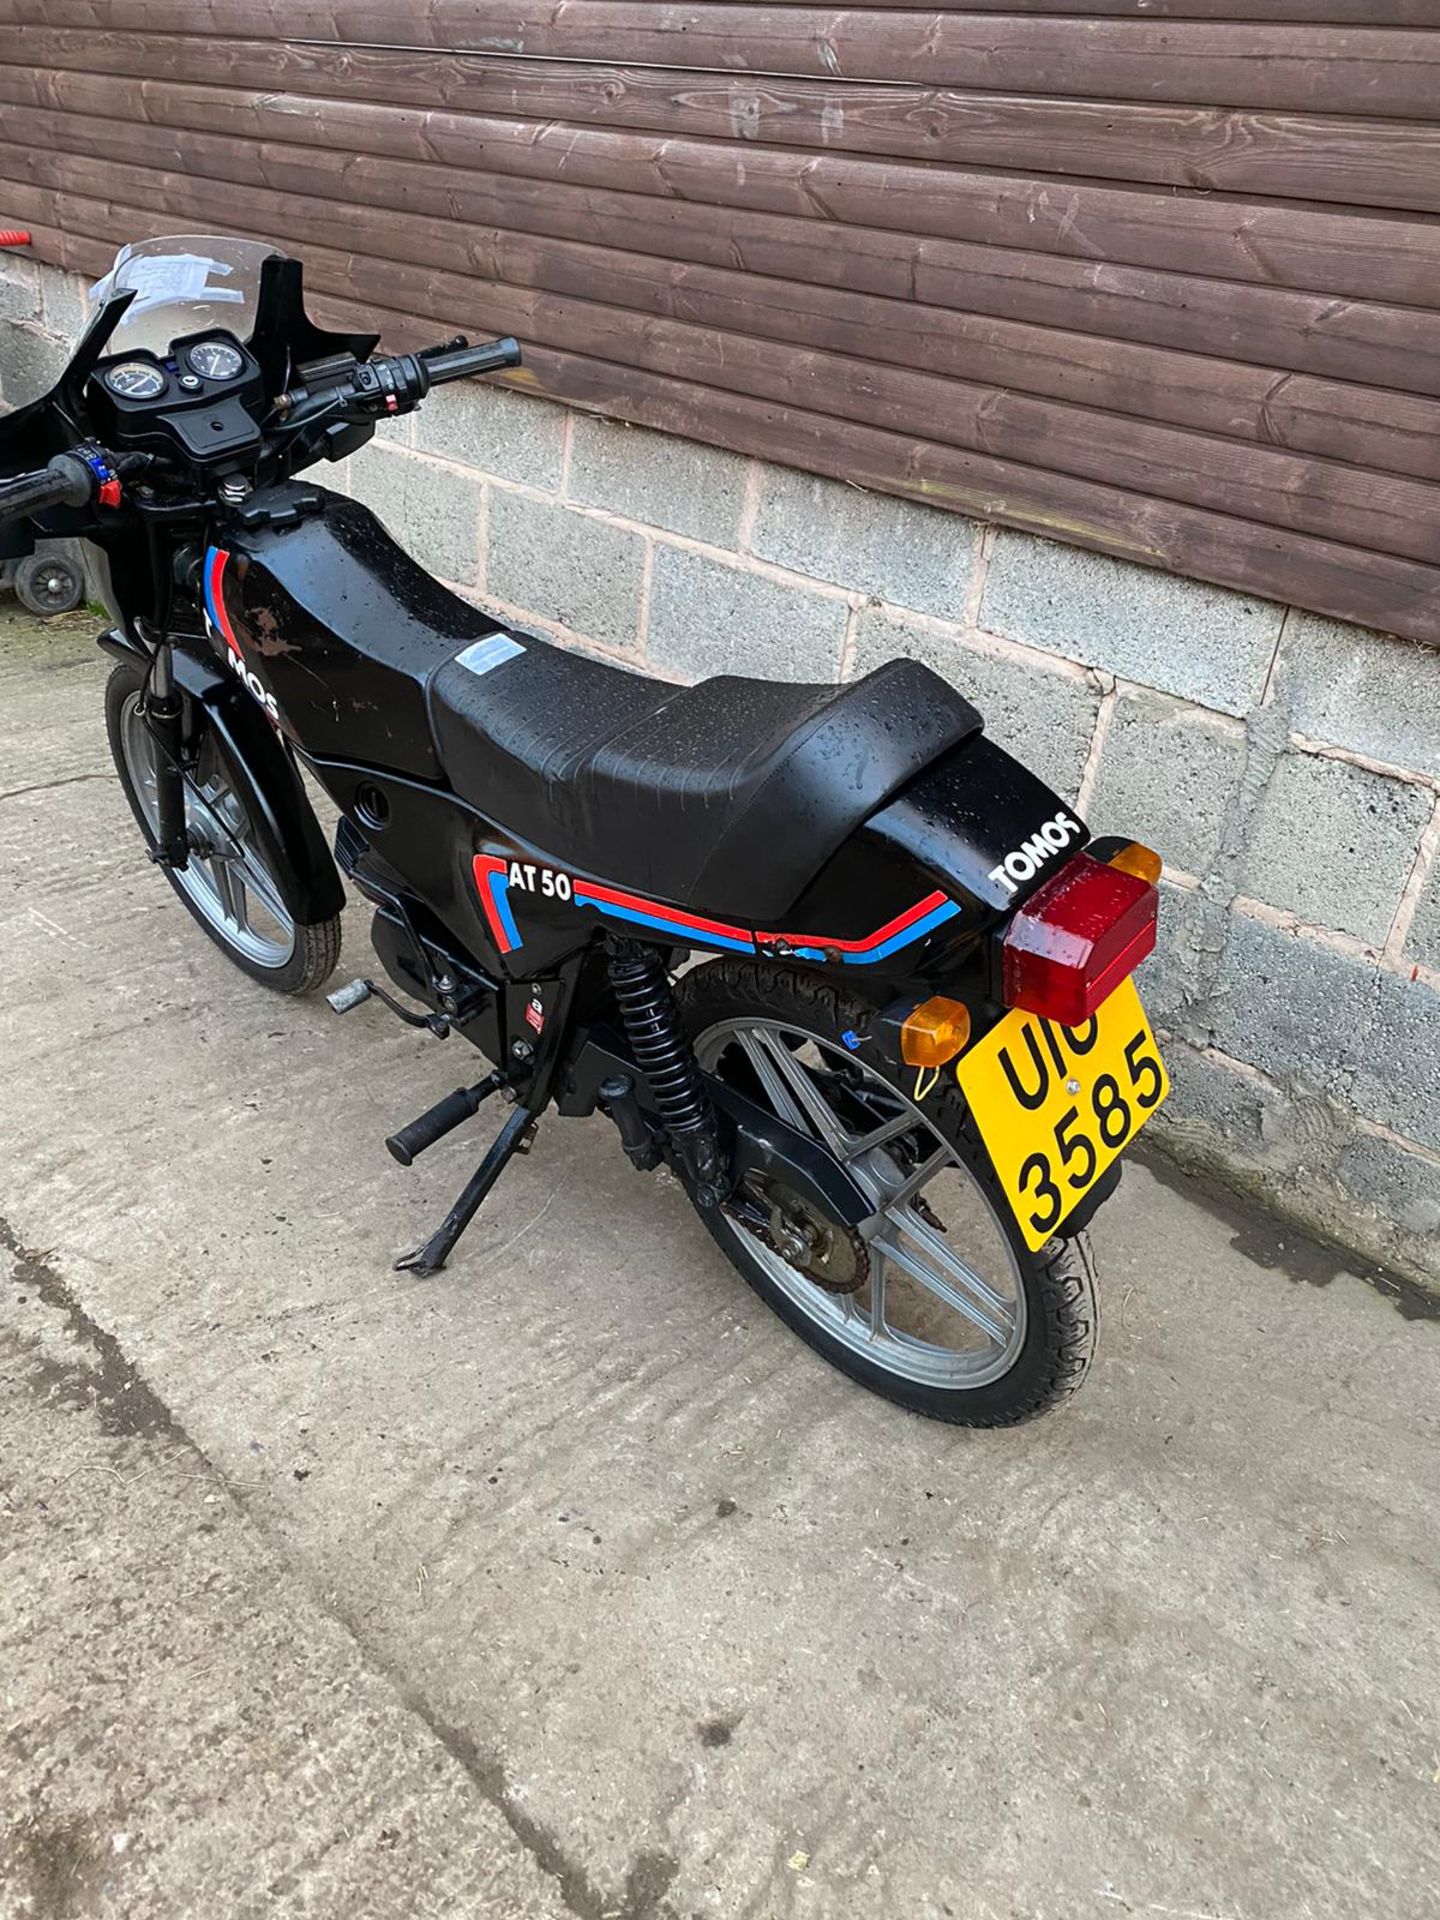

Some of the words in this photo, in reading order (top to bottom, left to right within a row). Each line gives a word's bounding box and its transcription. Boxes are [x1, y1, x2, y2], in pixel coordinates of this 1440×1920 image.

[509, 861, 537, 893] AT
[541, 868, 572, 901] 50
[987, 811, 1081, 893] TOMOS
[1018, 1029, 1162, 1234] 3585
